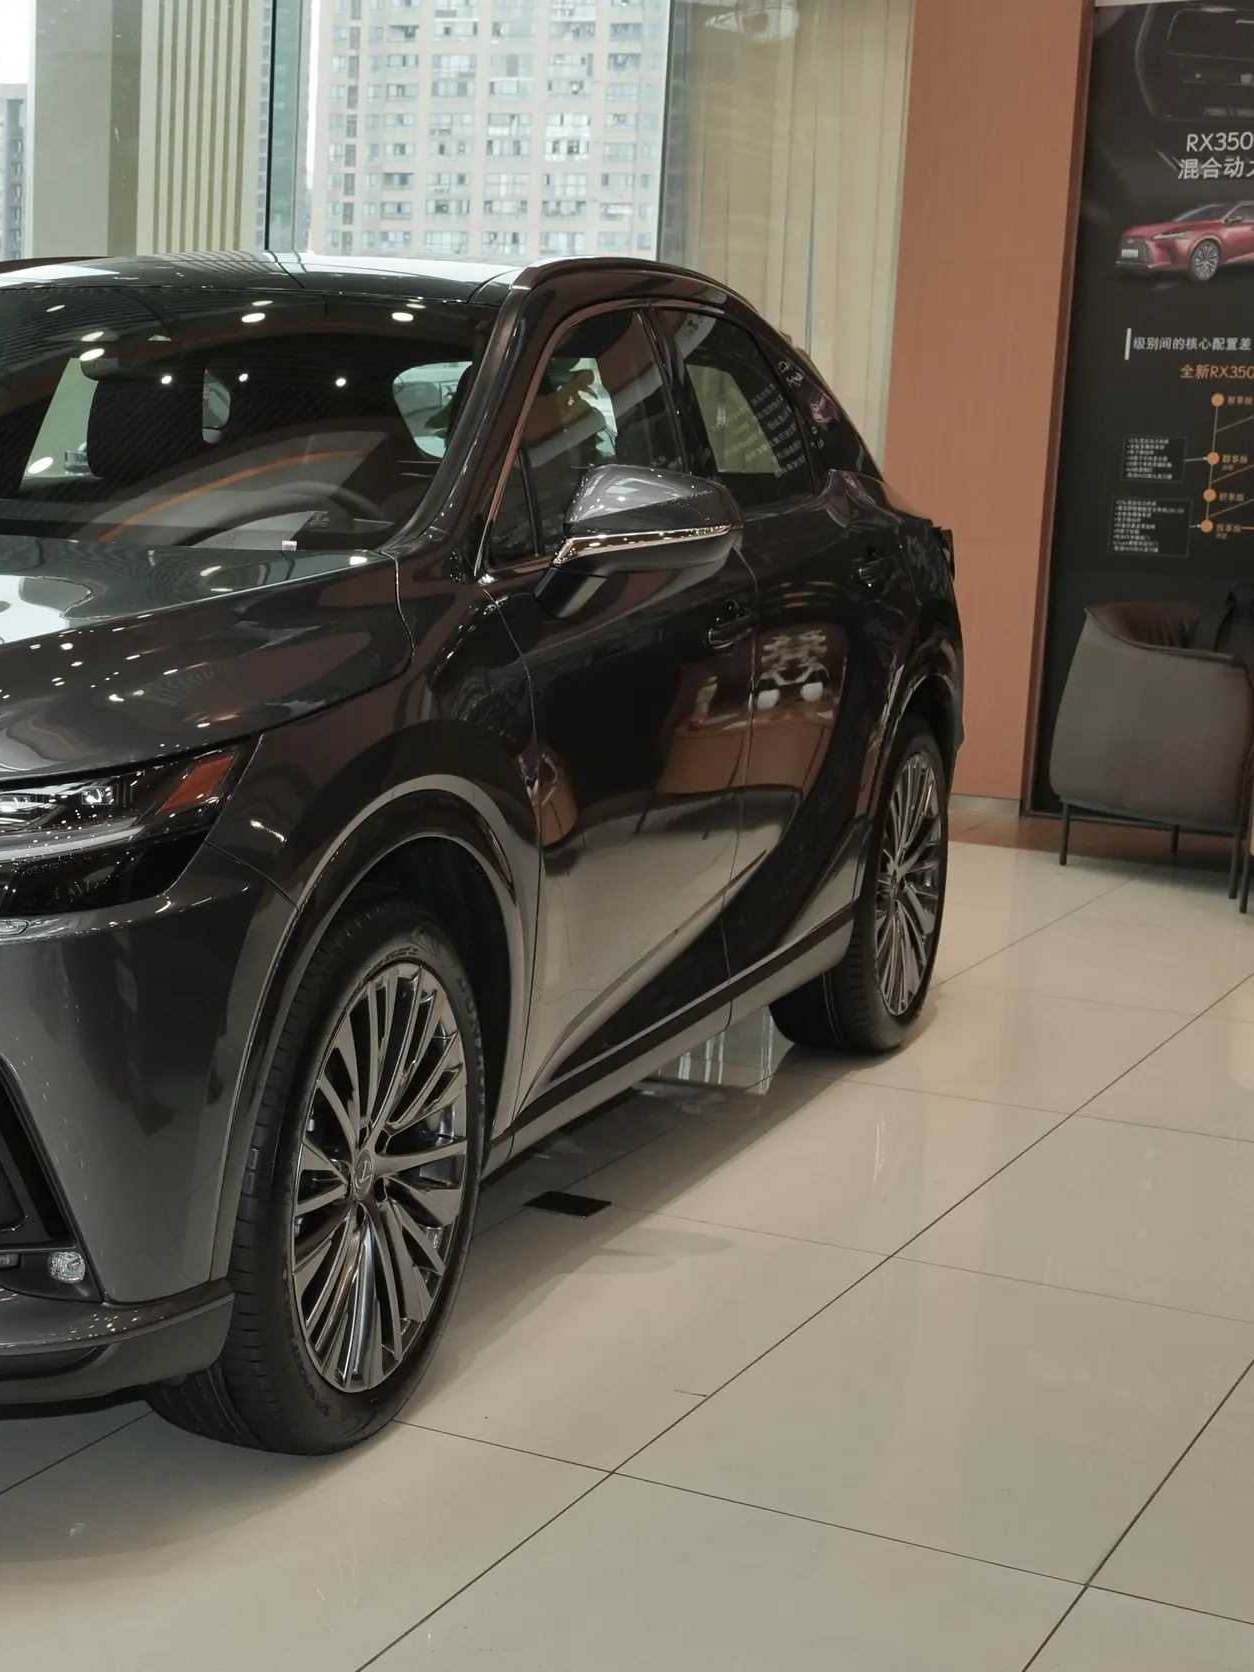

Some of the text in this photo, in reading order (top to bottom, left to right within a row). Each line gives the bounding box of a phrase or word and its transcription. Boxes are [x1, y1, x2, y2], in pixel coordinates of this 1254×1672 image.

[1186, 131, 1254, 153] RX350
[1132, 336, 1252, 351] 级别间的核心配置差
